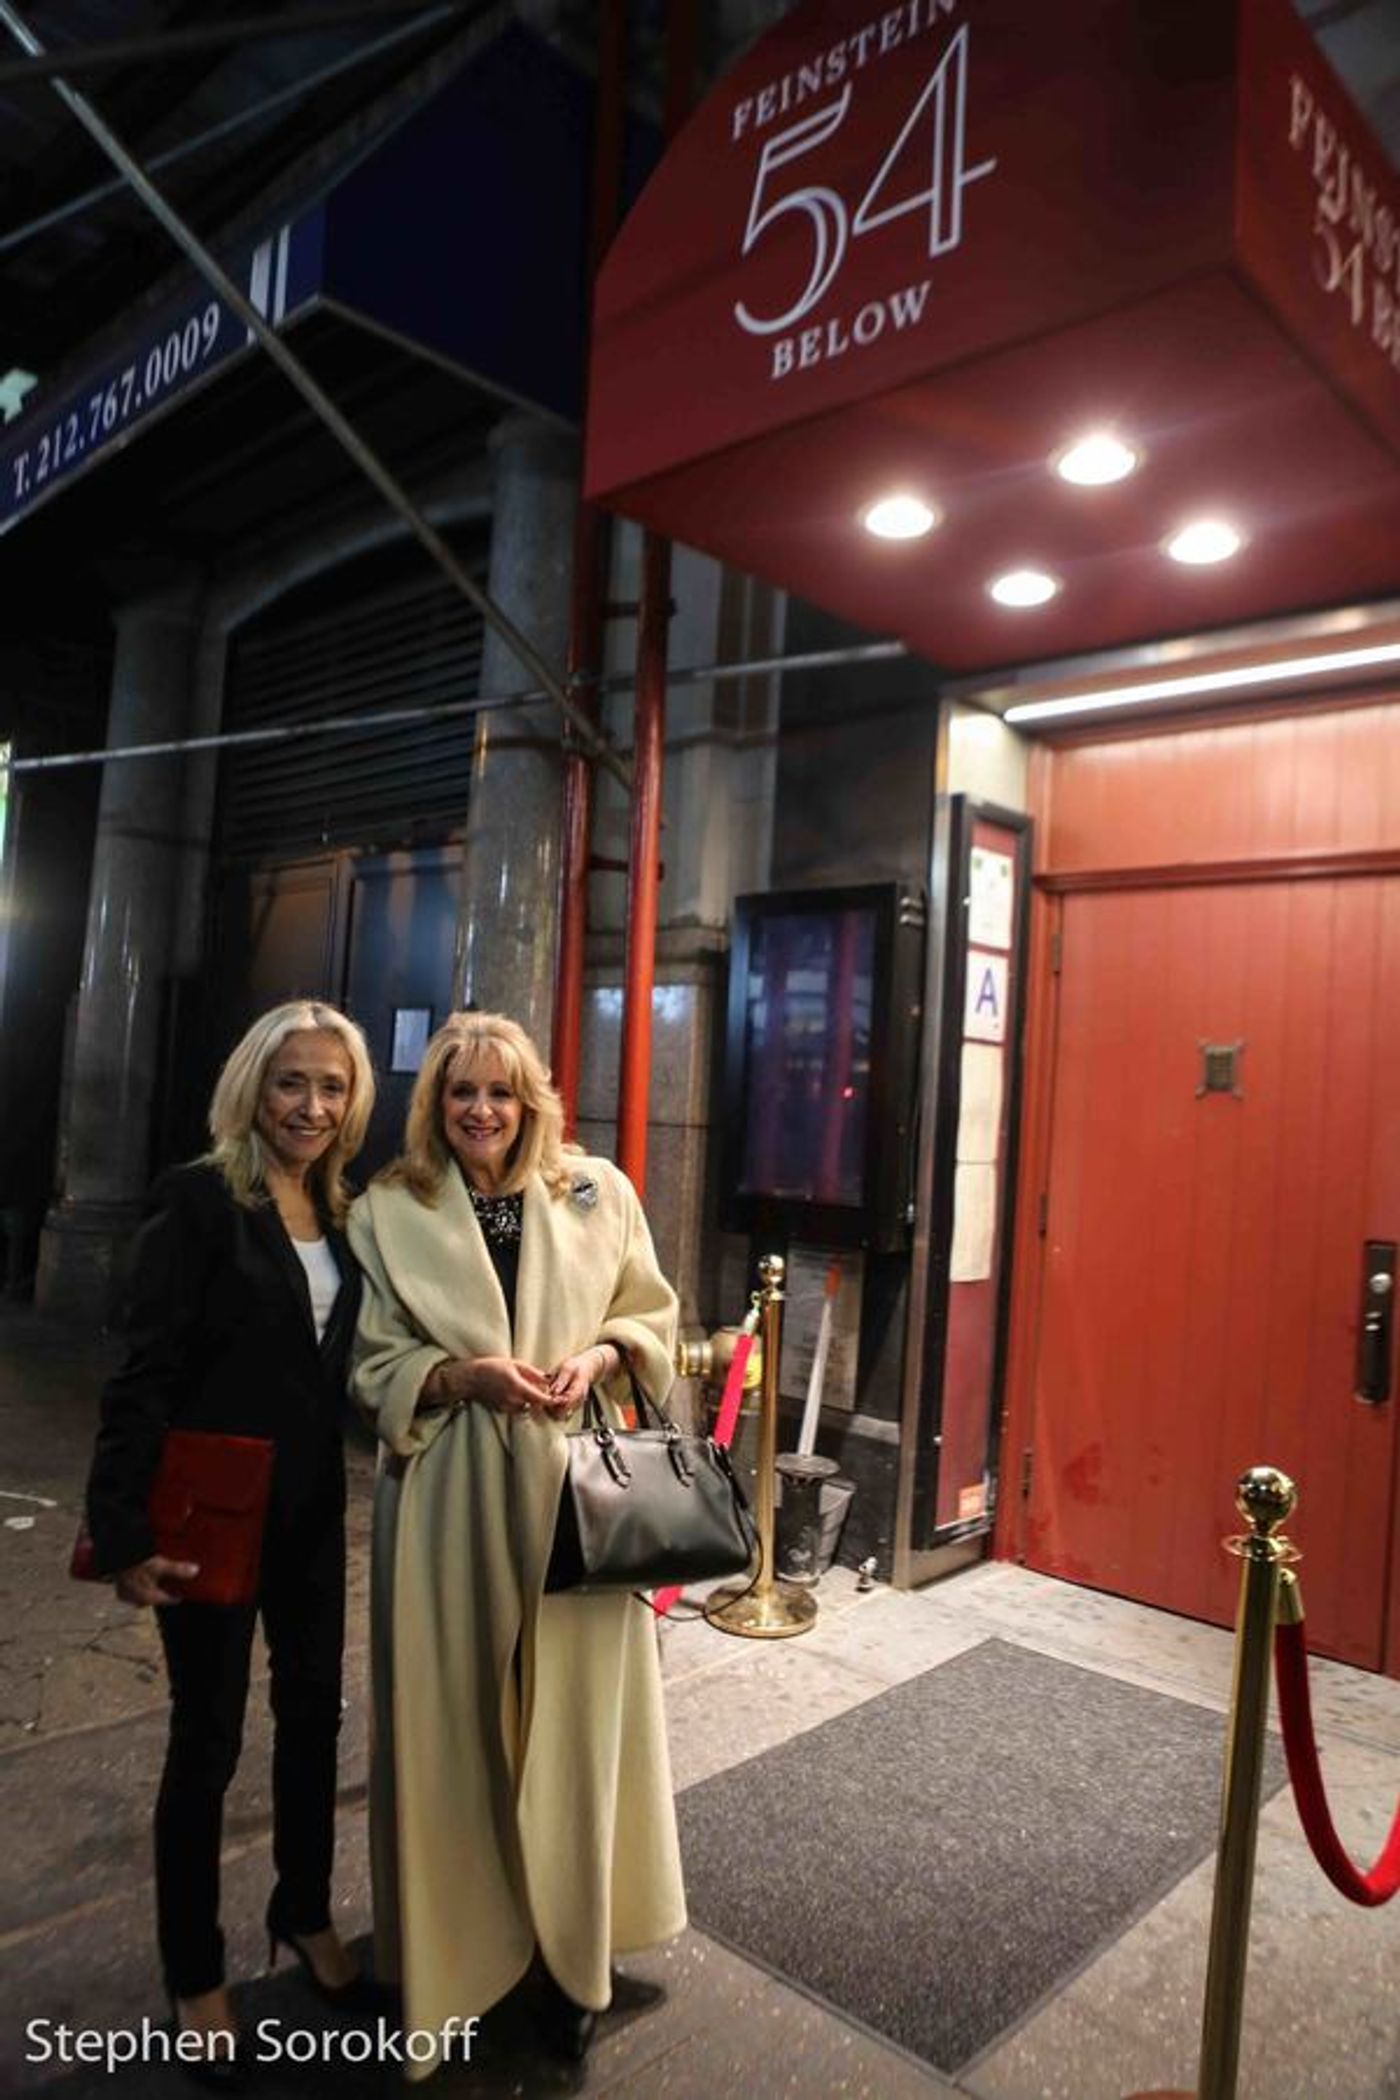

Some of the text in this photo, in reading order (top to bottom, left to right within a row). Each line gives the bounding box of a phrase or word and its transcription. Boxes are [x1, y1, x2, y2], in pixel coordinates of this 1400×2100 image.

[733, 23, 996, 334] 54
[36, 302, 220, 482] 212.767.0009
[771, 280, 933, 379] BELOW
[975, 968, 999, 1017] A
